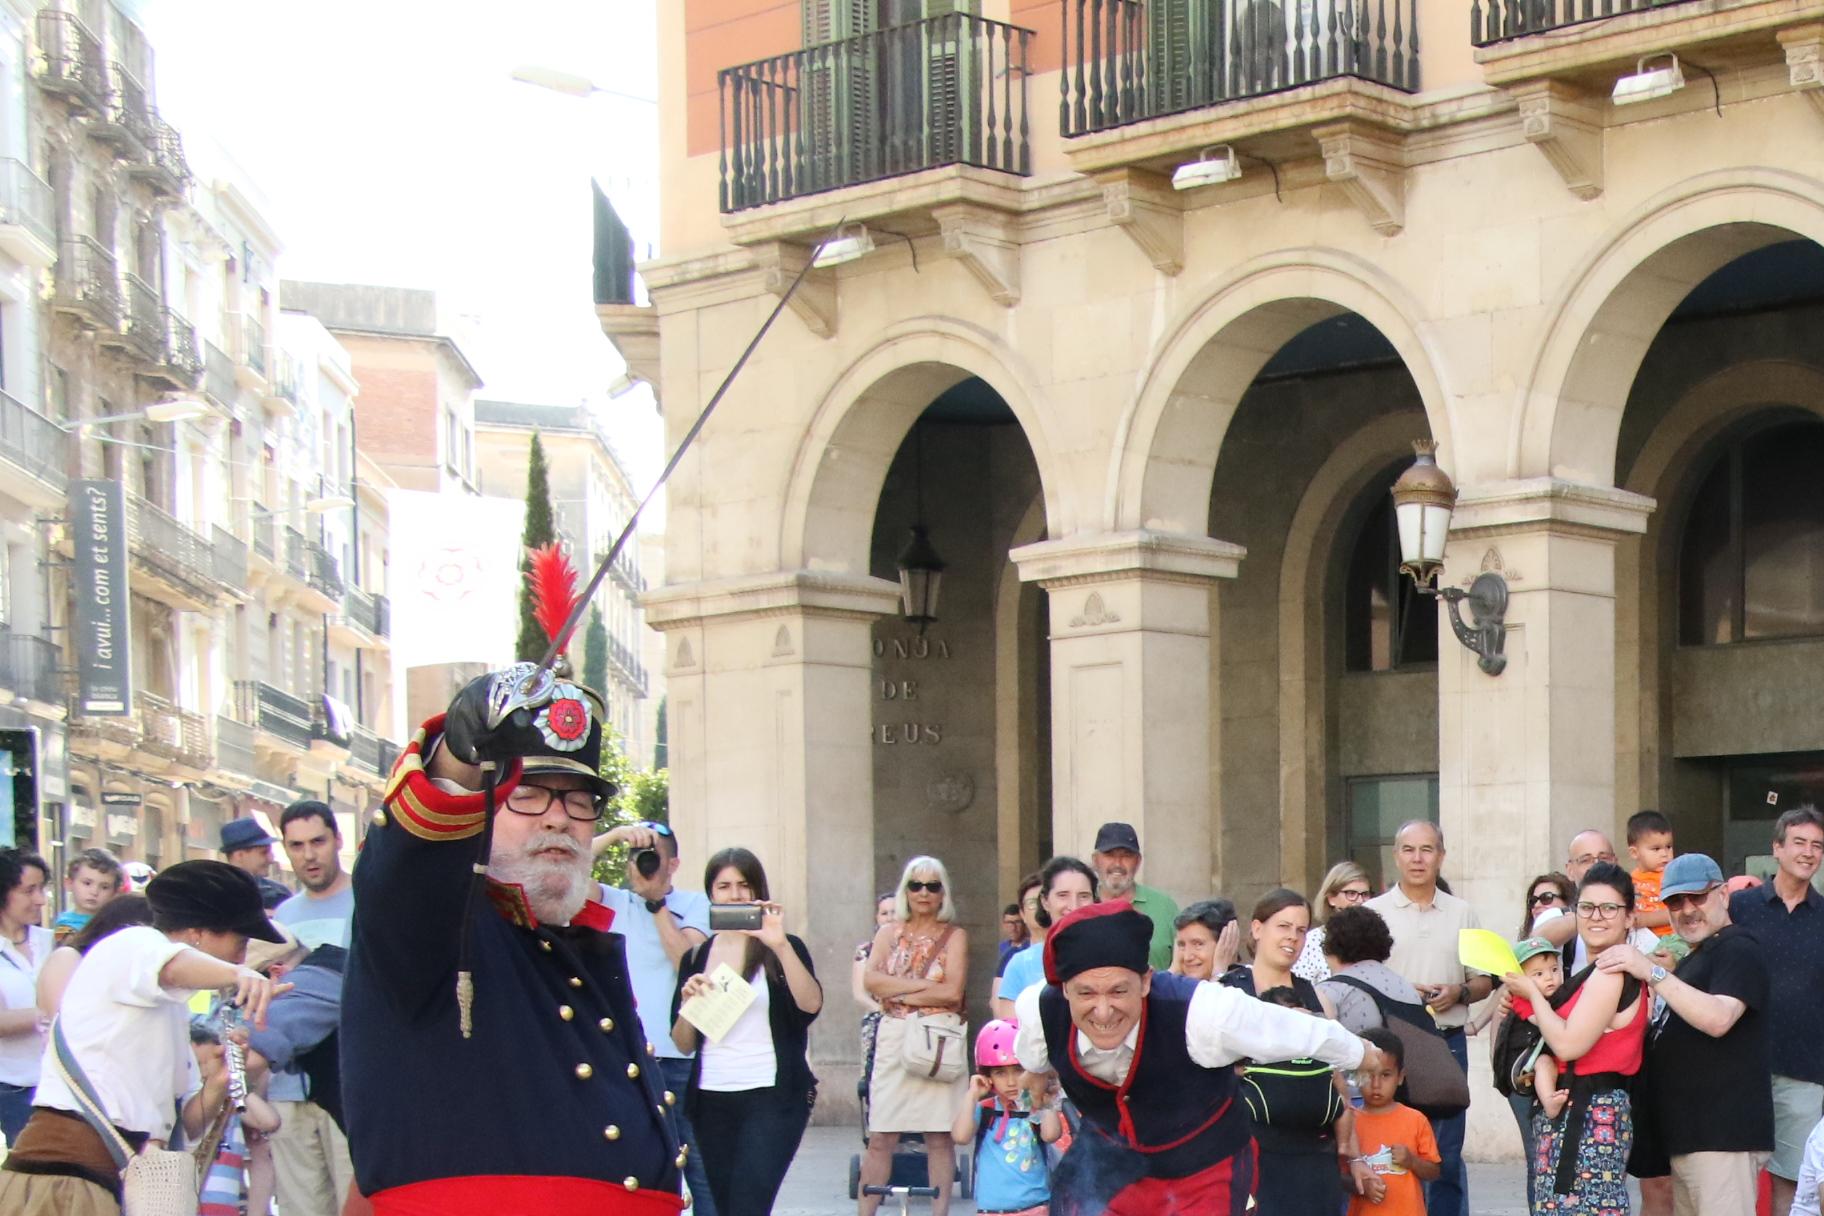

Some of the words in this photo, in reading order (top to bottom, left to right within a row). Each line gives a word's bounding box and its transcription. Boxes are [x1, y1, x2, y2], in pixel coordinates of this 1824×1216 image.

[86, 486, 108, 542] sents?
[91, 546, 109, 564] et
[94, 568, 111, 605] com
[873, 639, 950, 659] ONJA
[881, 680, 919, 700] DE
[871, 724, 942, 744] EUS
